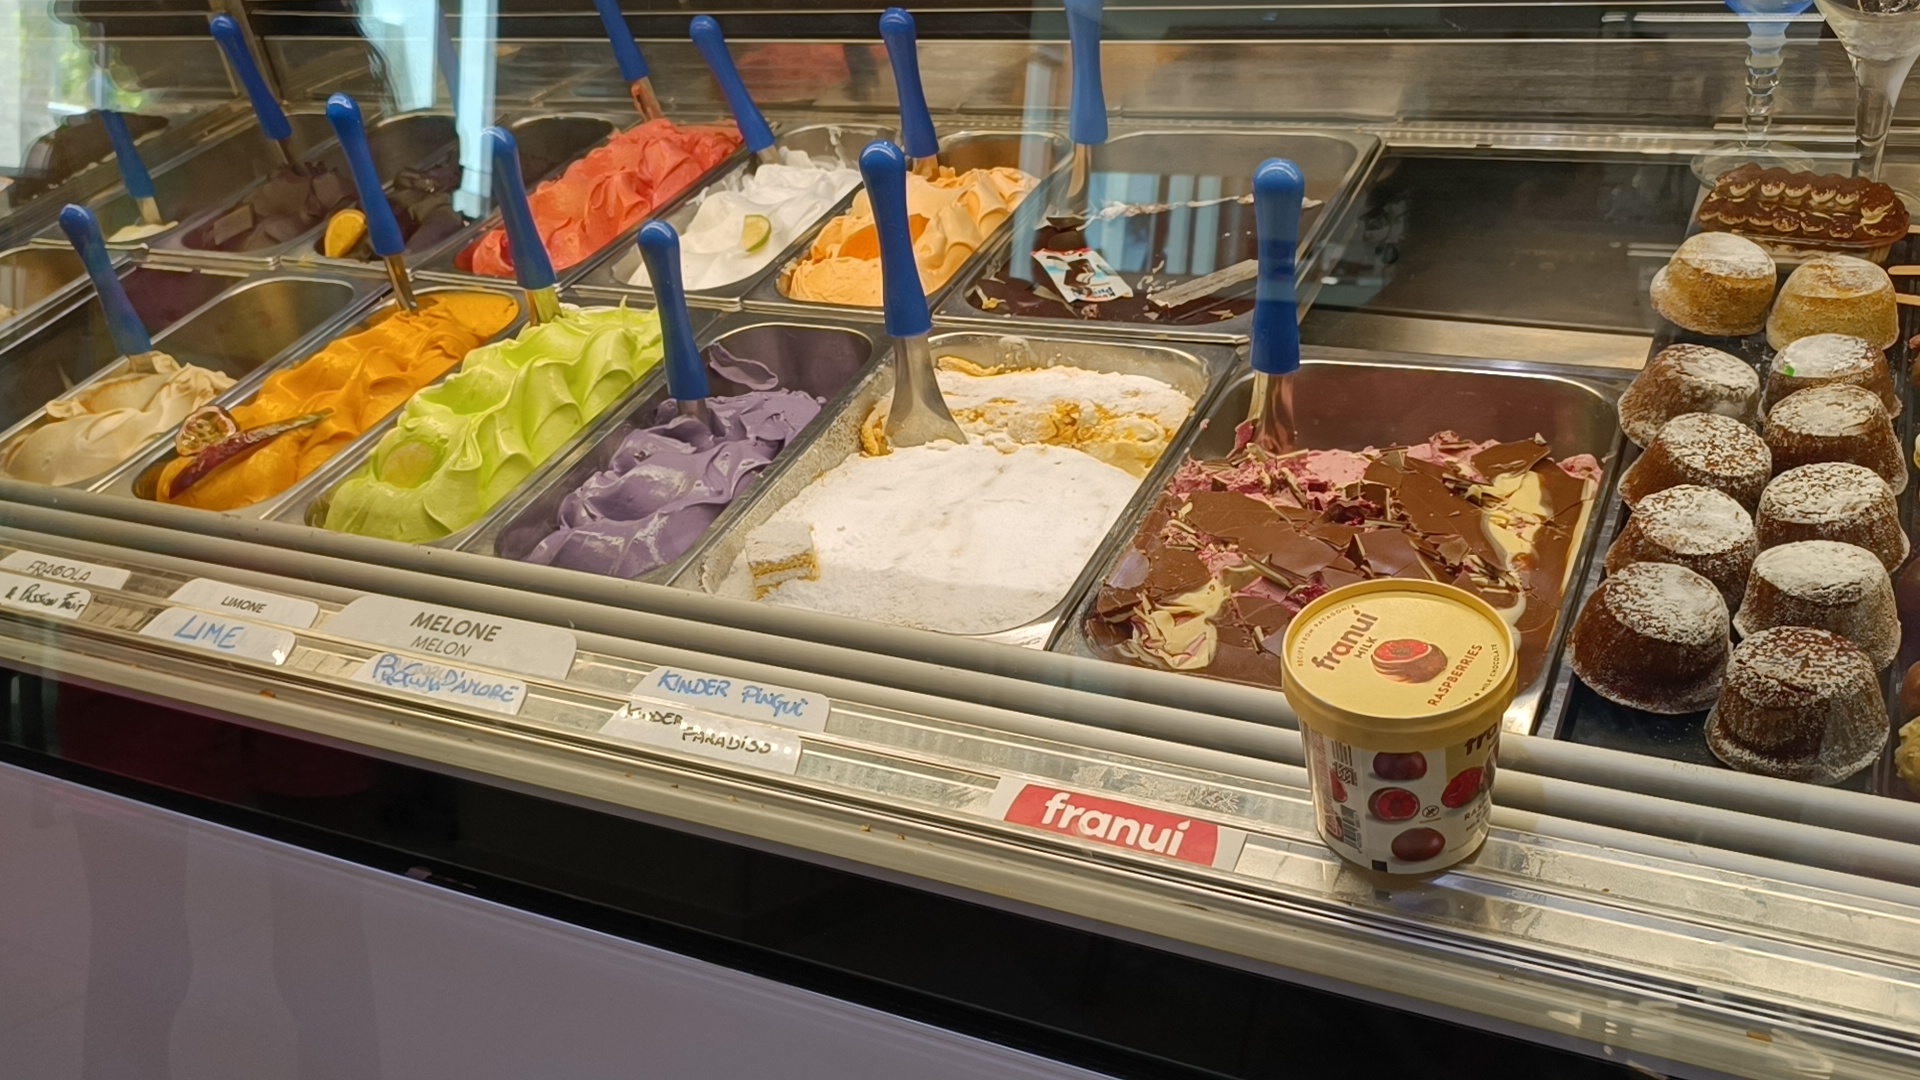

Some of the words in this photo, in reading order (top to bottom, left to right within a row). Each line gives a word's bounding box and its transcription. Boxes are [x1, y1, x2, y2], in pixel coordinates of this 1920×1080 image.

[25, 560, 92, 583] FRAGOLA
[221, 596, 267, 614] LIMONE
[1313, 604, 1356, 628] PATAGONIA
[174, 615, 245, 649] LIME
[410, 612, 502, 642] MELONE
[1311, 609, 1379, 671] franui
[410, 636, 472, 658] MELON
[1354, 636, 1378, 659] MILK
[657, 670, 731, 698] KINDER
[1427, 643, 1483, 707] RASPBERRIES
[1041, 792, 1191, 857] franui
